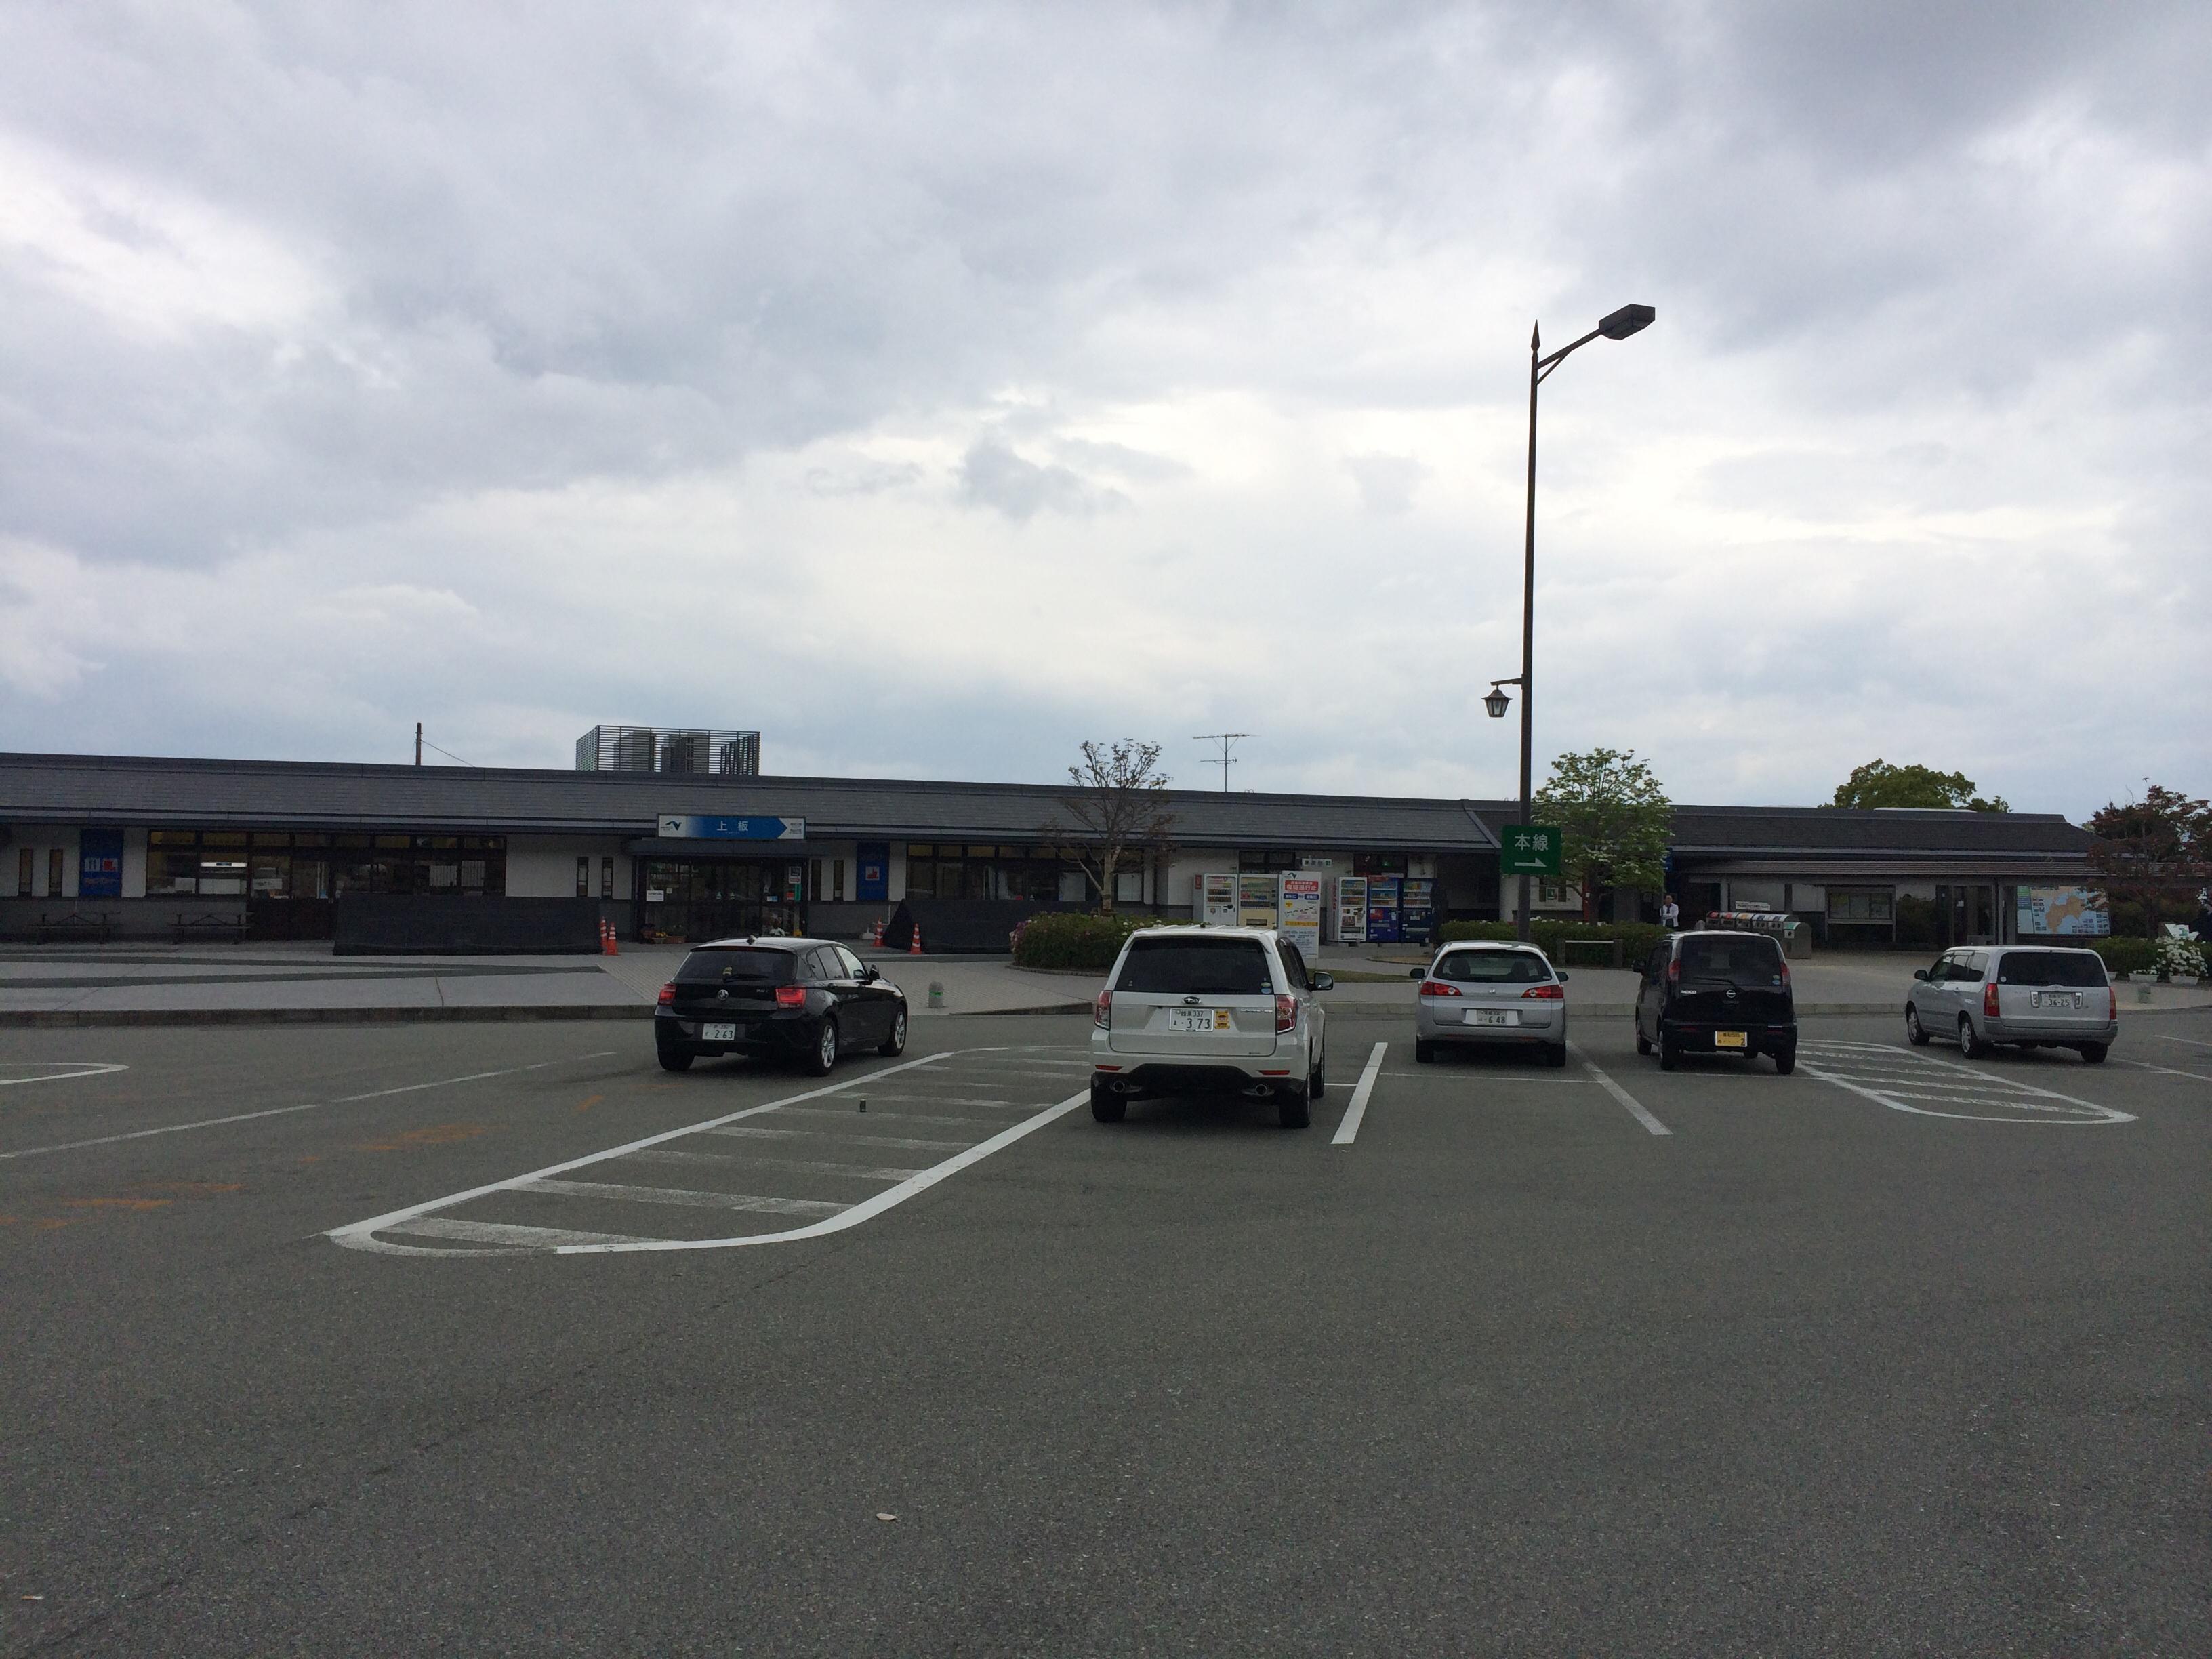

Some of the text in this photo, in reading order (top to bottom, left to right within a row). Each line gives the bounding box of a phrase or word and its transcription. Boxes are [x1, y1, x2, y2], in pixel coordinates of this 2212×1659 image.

[716, 820, 749, 832] 上板
[1515, 833, 1548, 851] 本線
[1187, 1018, 1210, 1029] 373
[714, 1029, 733, 1039] 263
